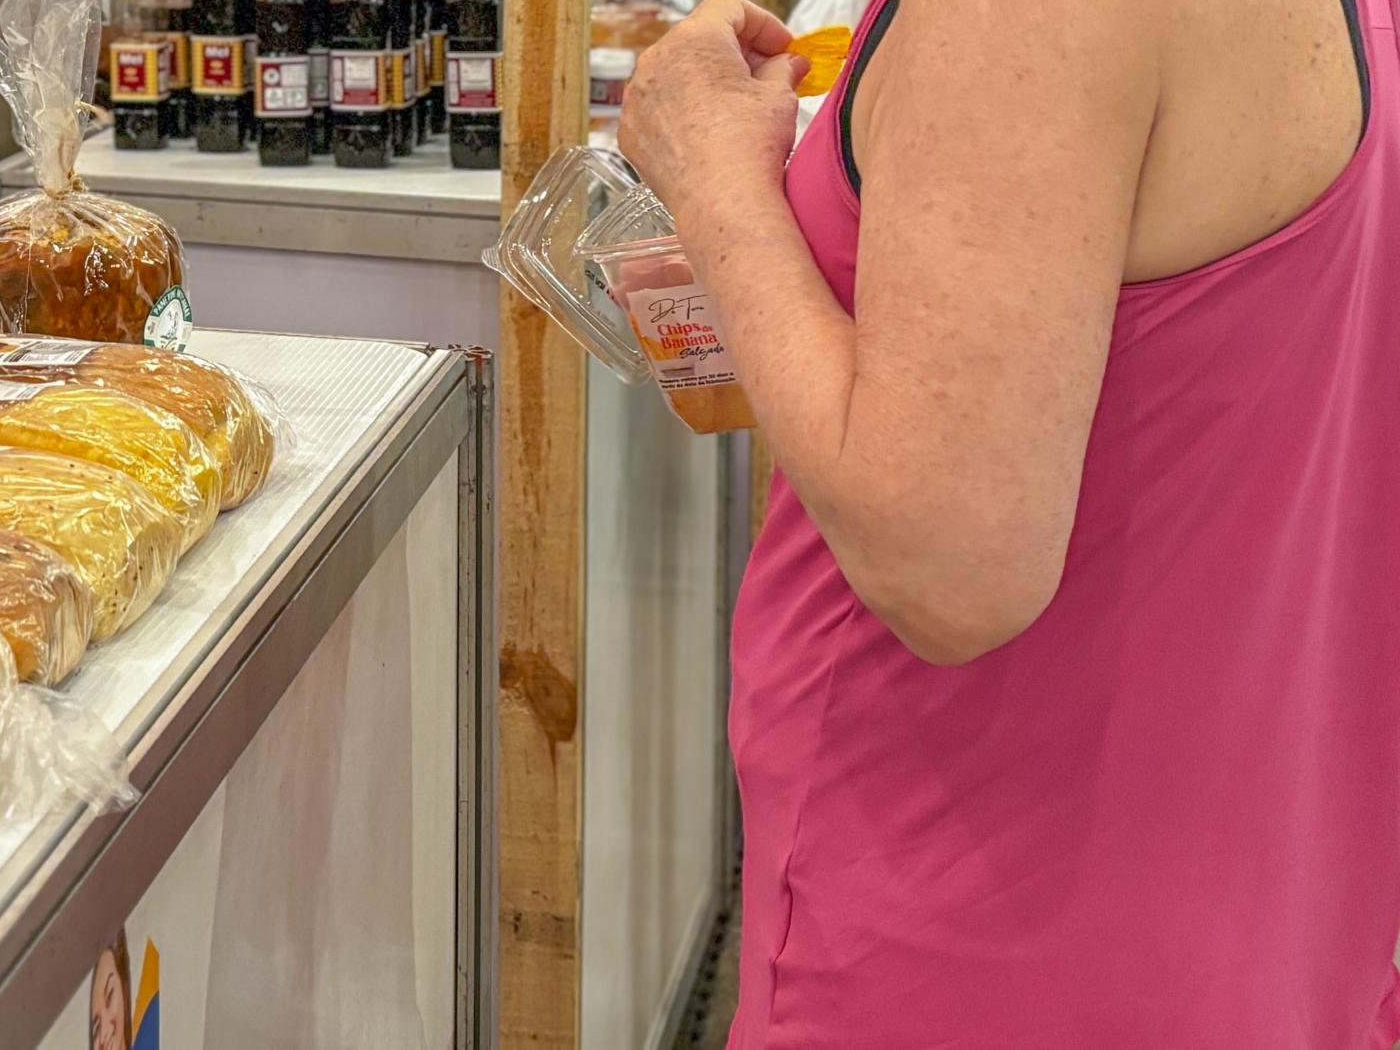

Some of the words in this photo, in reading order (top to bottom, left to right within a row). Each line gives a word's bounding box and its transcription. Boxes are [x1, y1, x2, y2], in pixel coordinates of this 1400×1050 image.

[657, 322, 702, 338] Chips
[660, 332, 718, 350] Banana
[679, 343, 725, 361] Salgado
